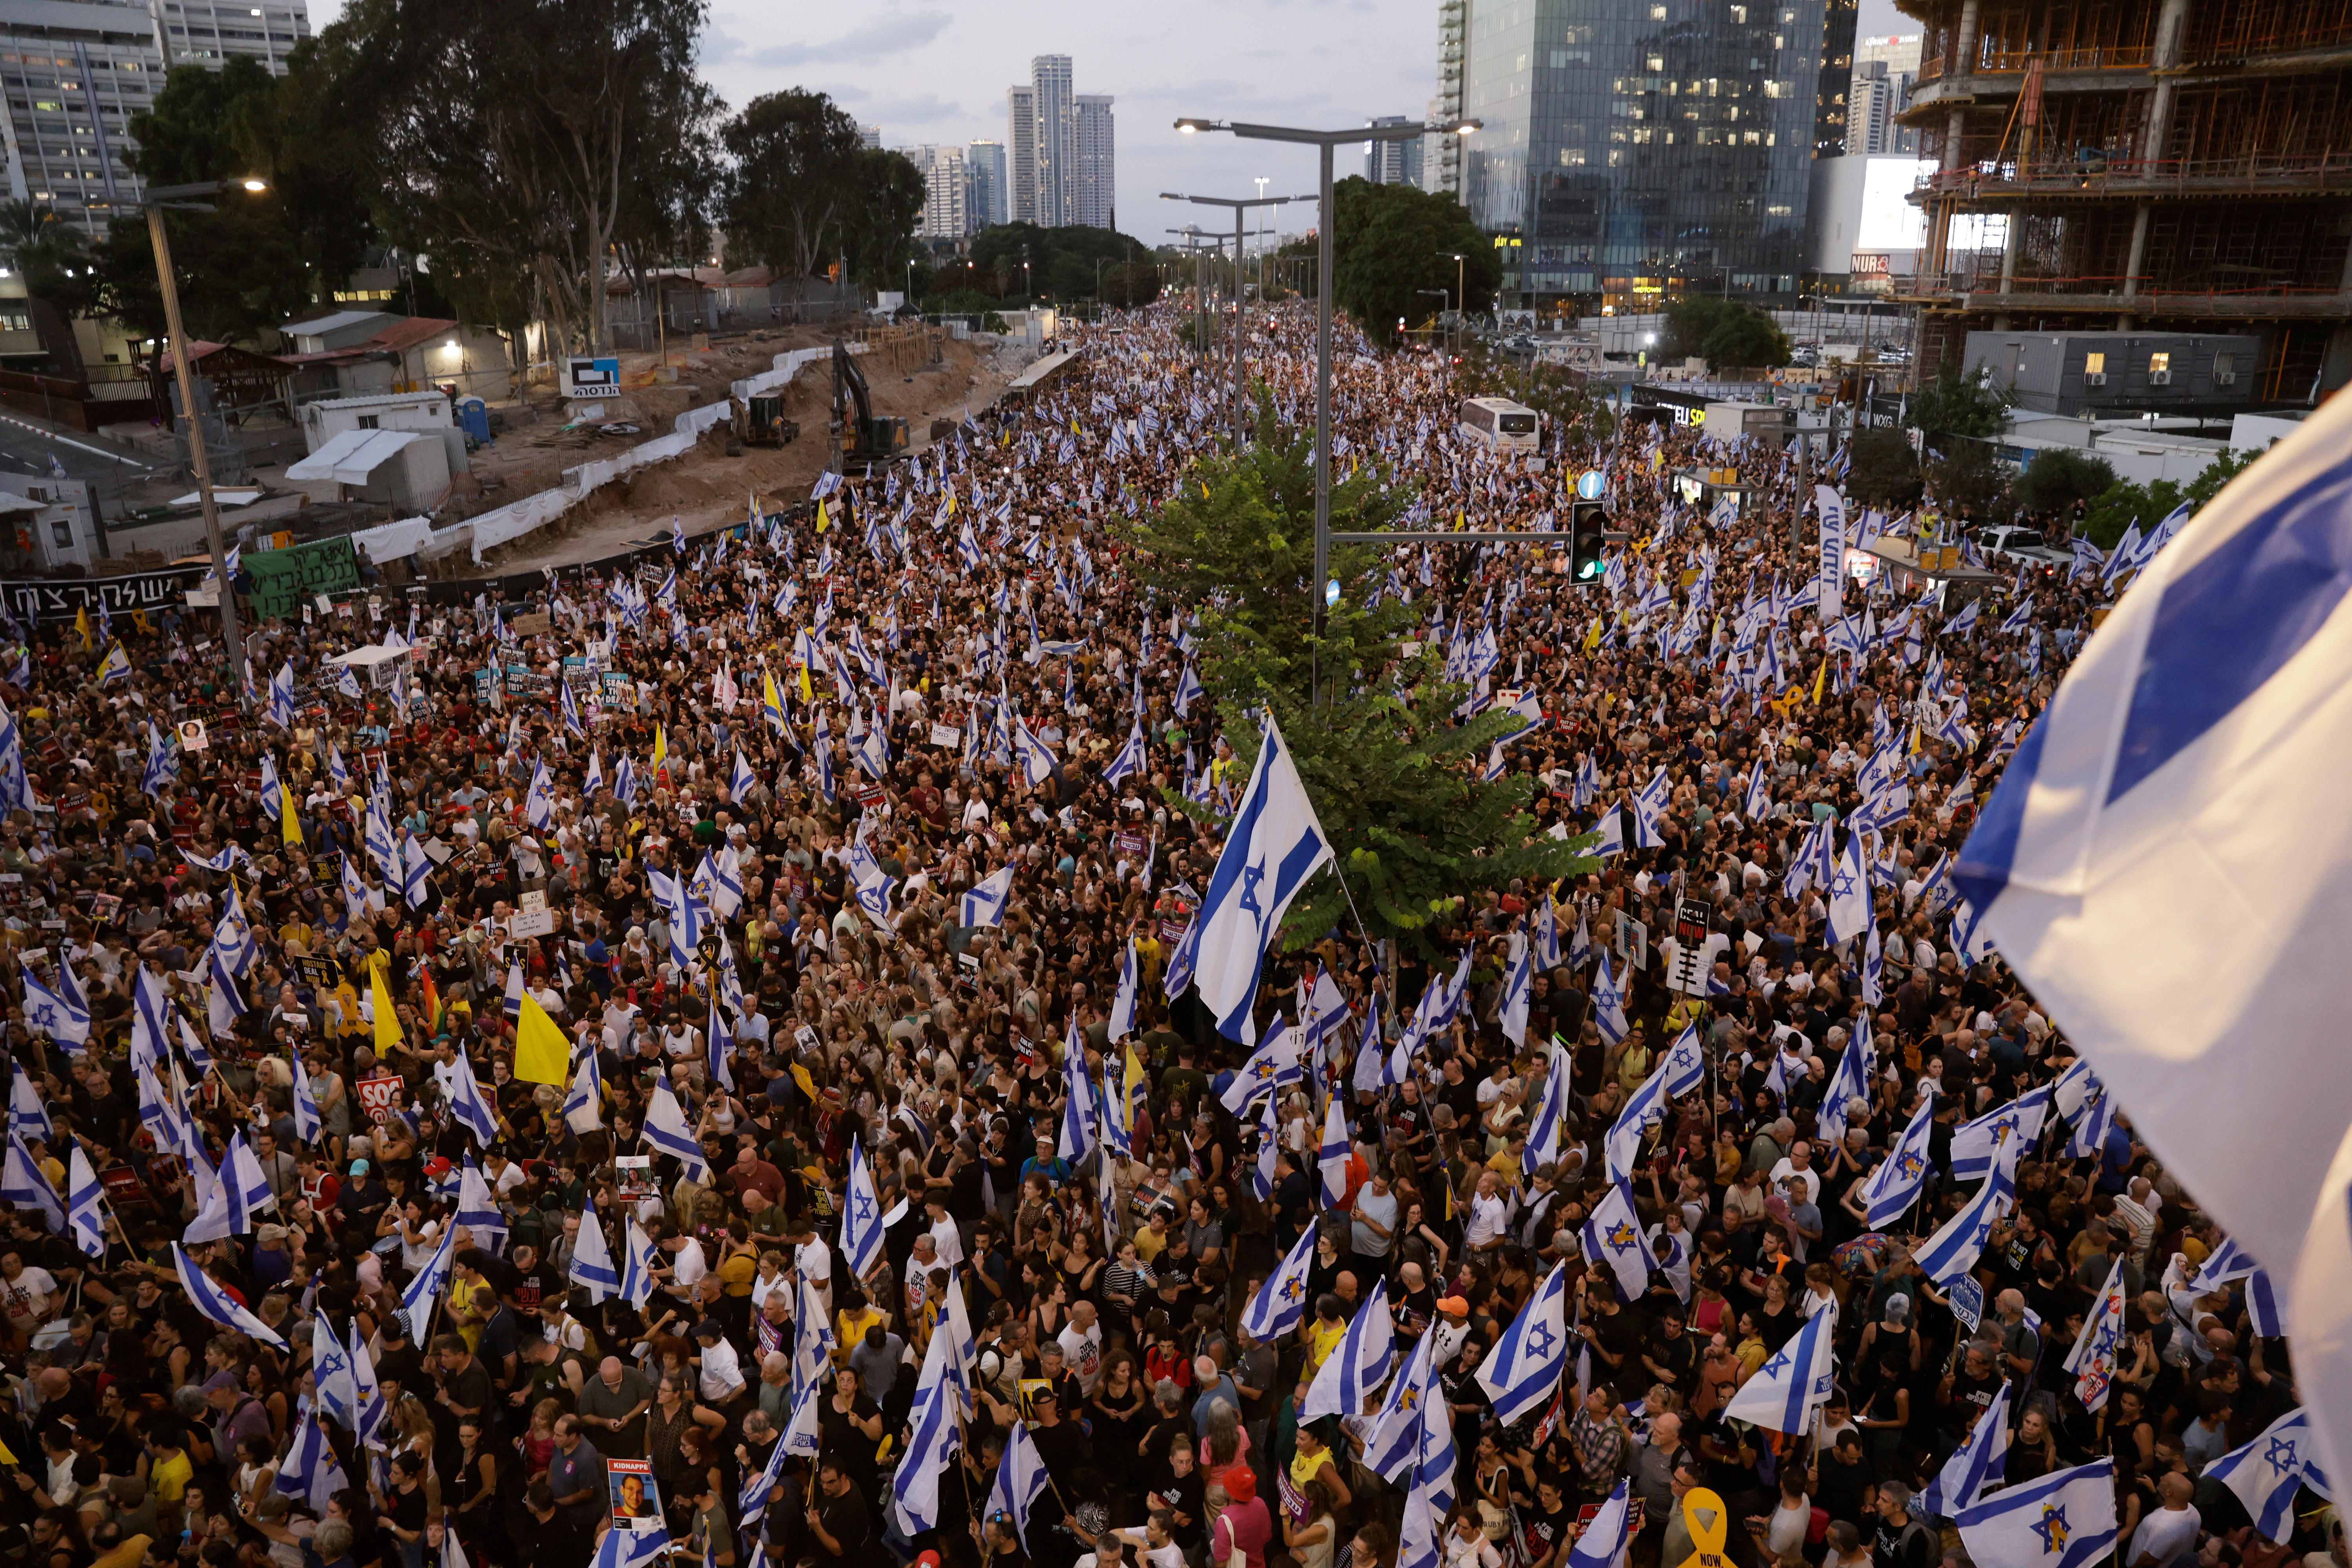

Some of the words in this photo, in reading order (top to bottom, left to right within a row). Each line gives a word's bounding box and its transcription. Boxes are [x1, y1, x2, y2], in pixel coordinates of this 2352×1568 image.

[1865, 37, 1888, 48] ATRIUM
[1495, 234, 1508, 249] play
[579, 387, 620, 396] הנדסה
[1873, 413, 1892, 428] WXG
[1122, 841, 1140, 849] עכשיו
[1164, 929, 1182, 938] עכשיו
[302, 959, 327, 969] HOSTAGE
[304, 967, 319, 976] DEAL
[1110, 1063, 1121, 1073] JUST
[1135, 1190, 1154, 1205] NAAM
[1131, 1202, 1141, 1212] FOR
[913, 1270, 926, 1284] אתה
[911, 1277, 925, 1292] הראש
[910, 1286, 922, 1299] אתה
[911, 1294, 921, 1306] אש
[759, 1328, 772, 1349] עכשיו
[1080, 1338, 1094, 1355] אתה
[1080, 1345, 1097, 1363] הראש
[1084, 1354, 1096, 1368] אתה
[1083, 1361, 1098, 1377] אשם
[1022, 1382, 1032, 1391] WE
[1279, 1479, 1299, 1513] עכשיו
[1293, 1493, 1305, 1504] לקבל
[1877, 1527, 1887, 1545] clean
[1880, 1541, 1893, 1559] code
[1700, 1553, 1724, 1568] NOW.
